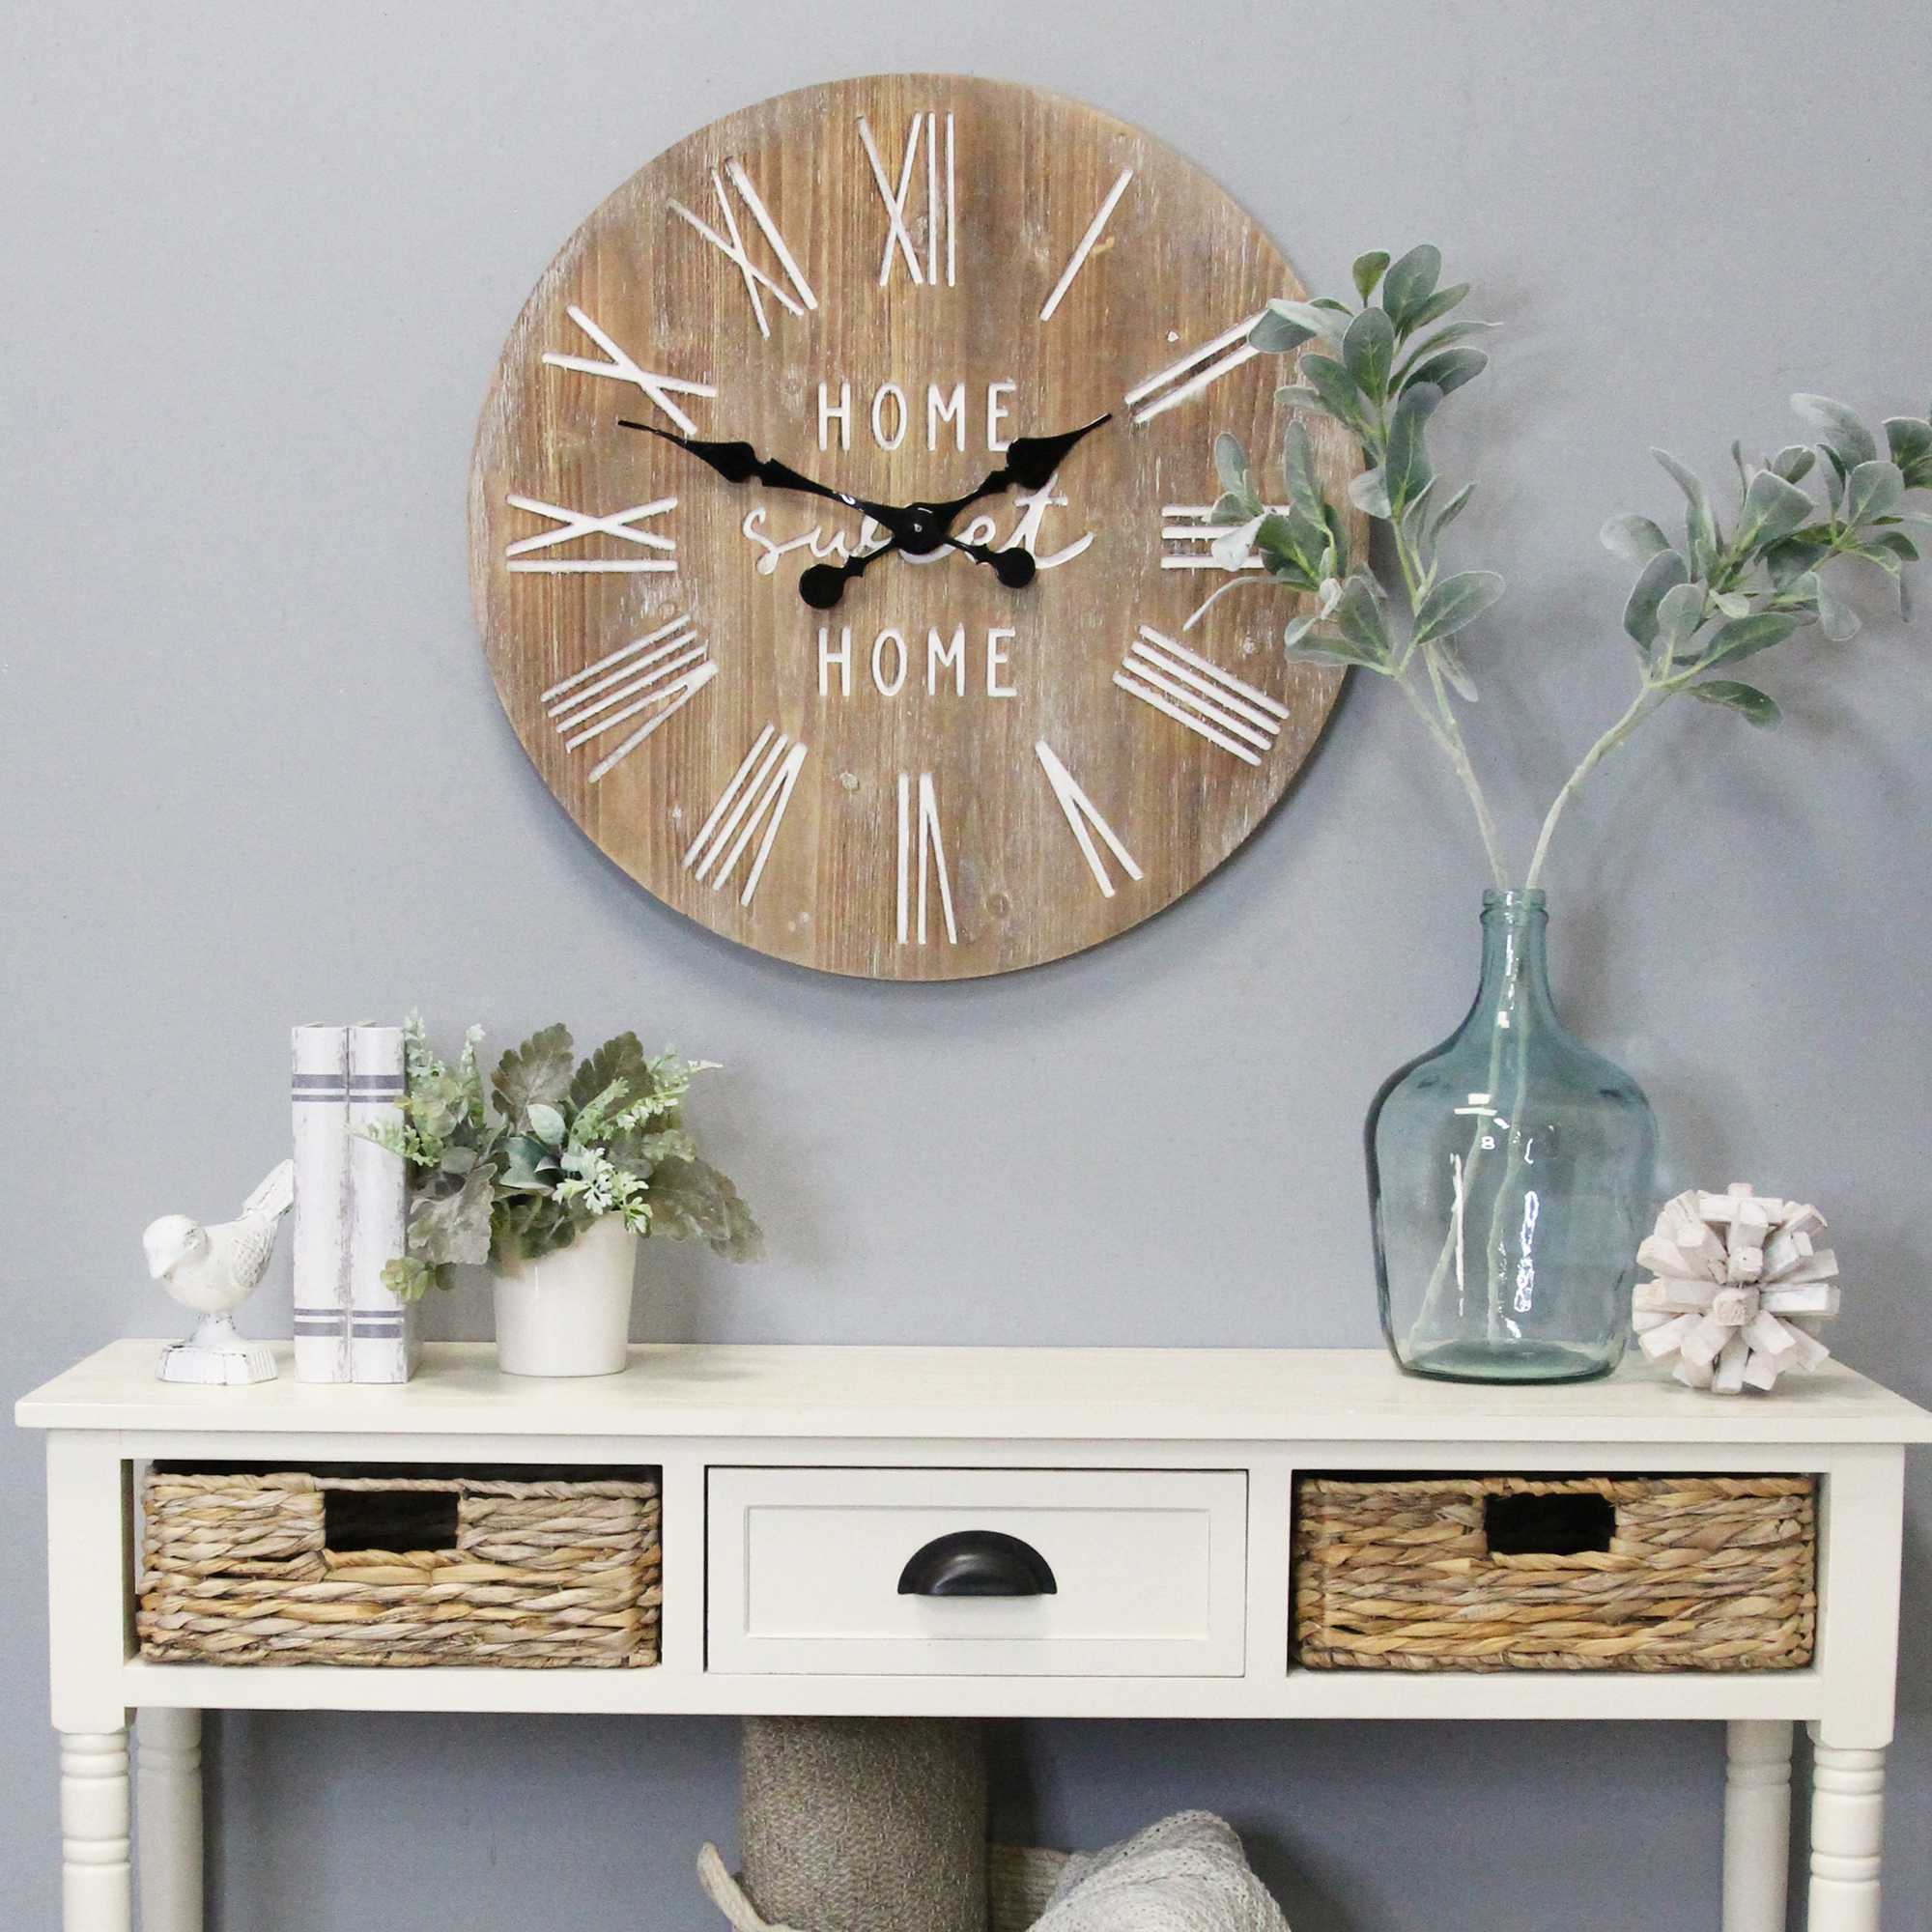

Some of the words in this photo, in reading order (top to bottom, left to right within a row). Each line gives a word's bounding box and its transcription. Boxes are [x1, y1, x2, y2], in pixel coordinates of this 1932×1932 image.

[857, 111, 956, 287] XII
[541, 305, 717, 435] X
[817, 381, 1016, 452] HOME
[817, 625, 1018, 697] HOME
[897, 772, 957, 945] VI
